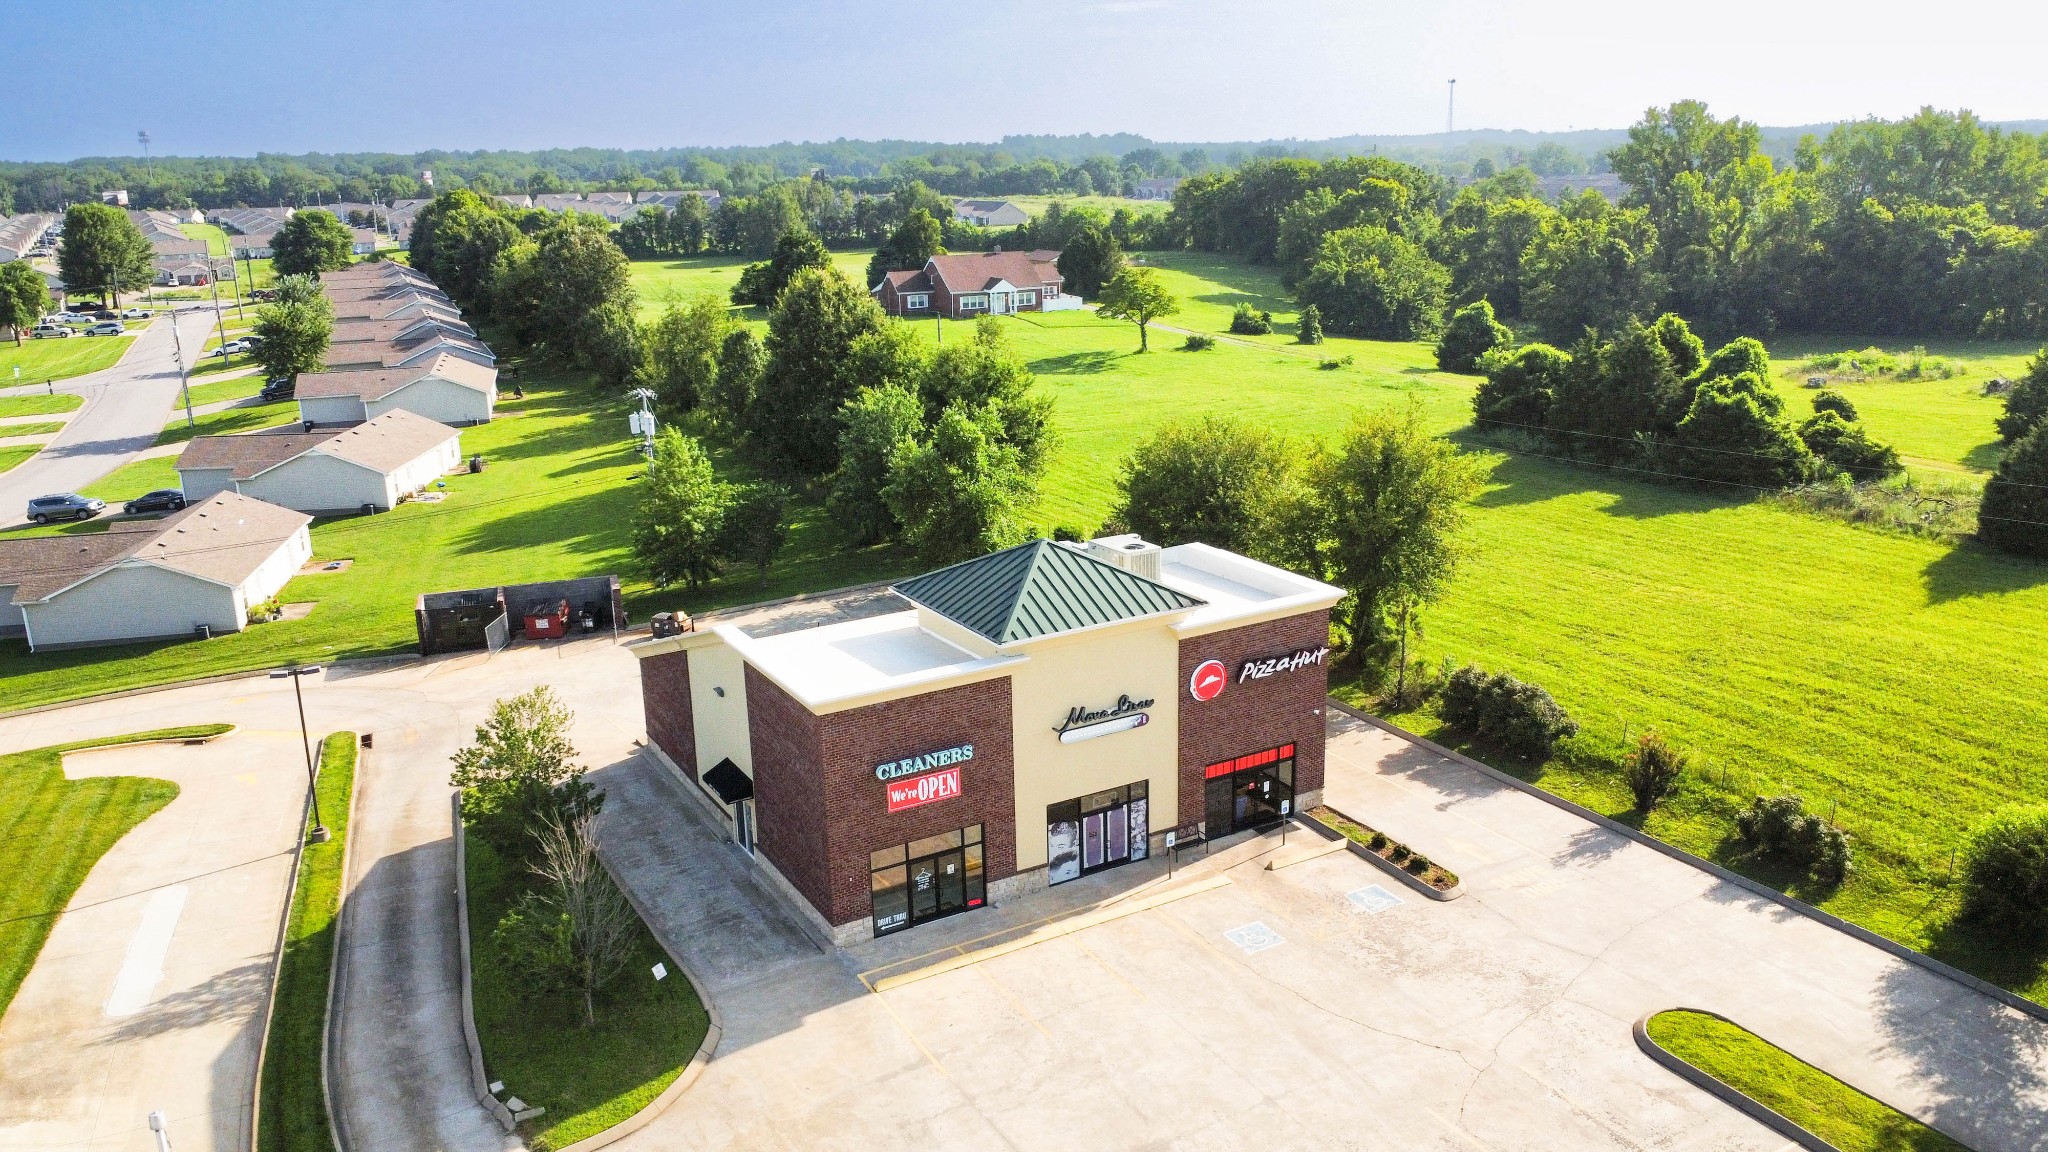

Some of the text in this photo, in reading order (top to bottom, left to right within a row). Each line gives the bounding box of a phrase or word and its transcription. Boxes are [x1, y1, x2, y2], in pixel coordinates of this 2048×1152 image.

[1239, 646, 1330, 684] Pizza Hut
[875, 744, 974, 780] CLEANERS
[891, 771, 957, 803] We're OPEN
